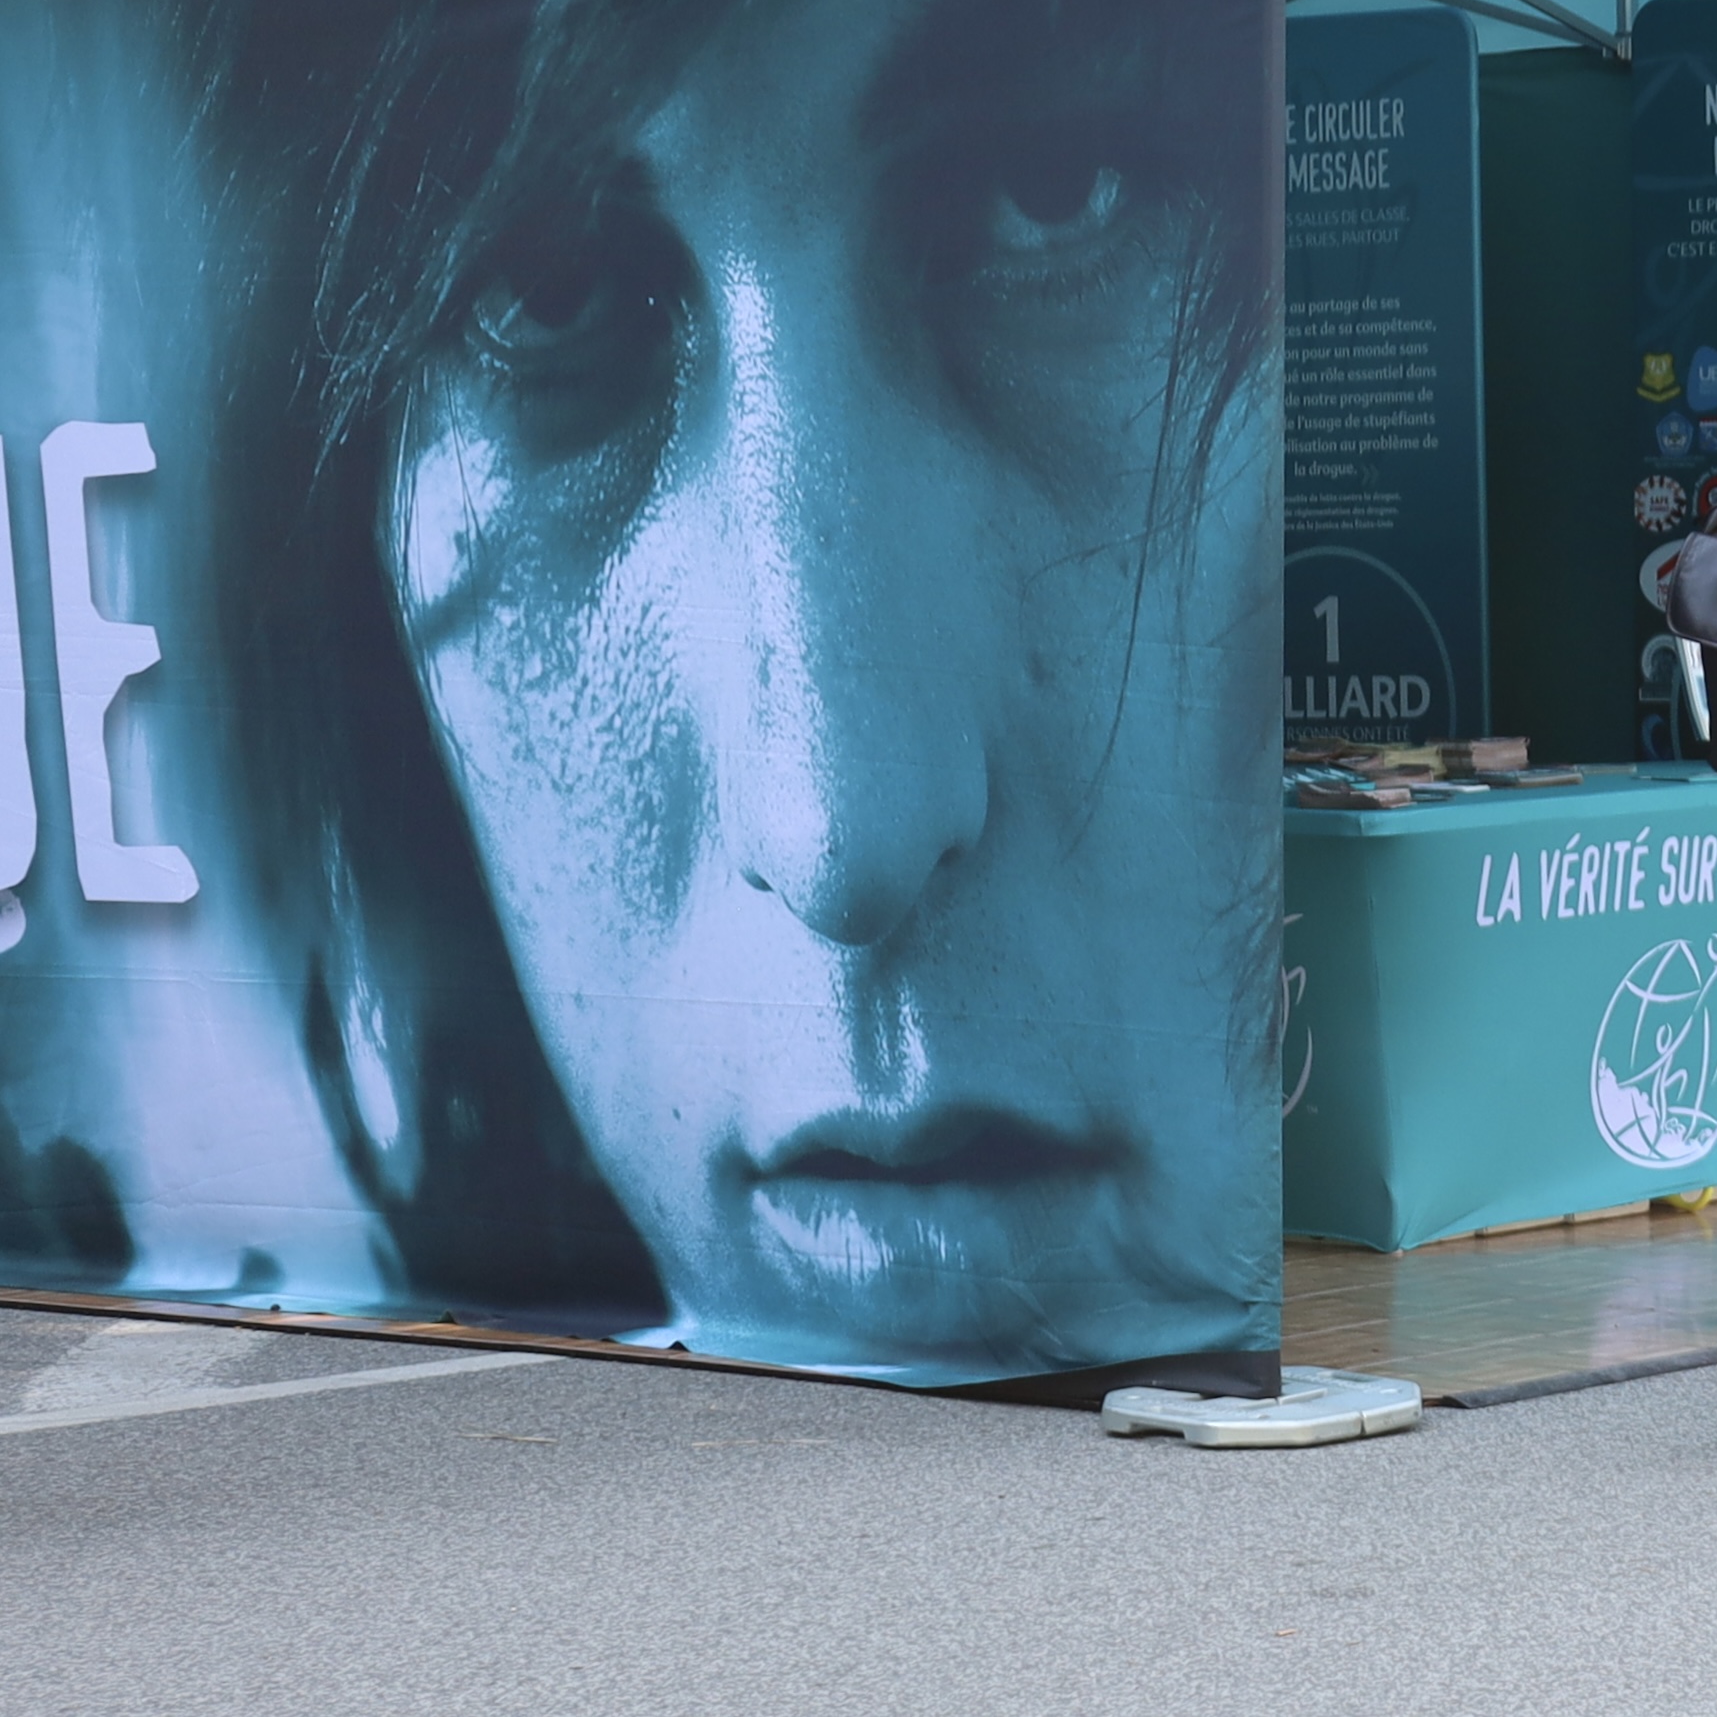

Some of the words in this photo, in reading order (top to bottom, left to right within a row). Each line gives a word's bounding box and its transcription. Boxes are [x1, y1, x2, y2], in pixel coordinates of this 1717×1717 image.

[1305, 98, 1405, 143] CIRCULER
[1288, 148, 1390, 193] MESSAGE
[1688, 198, 1704, 213] LE
[1295, 210, 1339, 227] SALLES
[1341, 209, 1357, 225] DE
[1342, 228, 1399, 245] PARTOUT
[1667, 241, 1705, 257] C'EST
[1290, 302, 1305, 314] au
[1309, 298, 1359, 317] partage
[1362, 295, 1377, 311] de
[1381, 296, 1400, 310] ses
[1304, 323, 1317, 336] et
[1320, 320, 1336, 335] de
[1338, 323, 1352, 335] sa
[1356, 317, 1436, 337] compétence,
[1285, 349, 1299, 360] on
[1302, 346, 1332, 364] pour
[1334, 345, 1350, 358] un
[1353, 341, 1396, 357] monde
[1399, 342, 1429, 356] sans
[1286, 368, 1299, 384] ué
[1302, 370, 1317, 383] un
[1320, 367, 1345, 382] rôle
[1347, 363, 1403, 381] essentiel
[1406, 363, 1437, 378] dans
[1303, 392, 1337, 405] notre
[1340, 389, 1415, 409] programme
[1418, 386, 1434, 402] de
[1297, 414, 1342, 433] l'usage
[1345, 413, 1360, 428] de
[1363, 411, 1436, 431] stupéfiants
[1286, 437, 1337, 453] ilisation
[1340, 439, 1356, 451] au
[1359, 434, 1420, 454] problème
[1423, 433, 1439, 448] de
[1294, 461, 1306, 476] la
[1309, 460, 1358, 479] drogue.
[1313, 595, 1340, 663] 1
[1284, 675, 1430, 719] LLIARD
[1286, 725, 1350, 741] RSONNES
[1352, 725, 1381, 741] ONT
[1476, 851, 1522, 927] LA
[1540, 826, 1650, 920] VÉRITÉ
